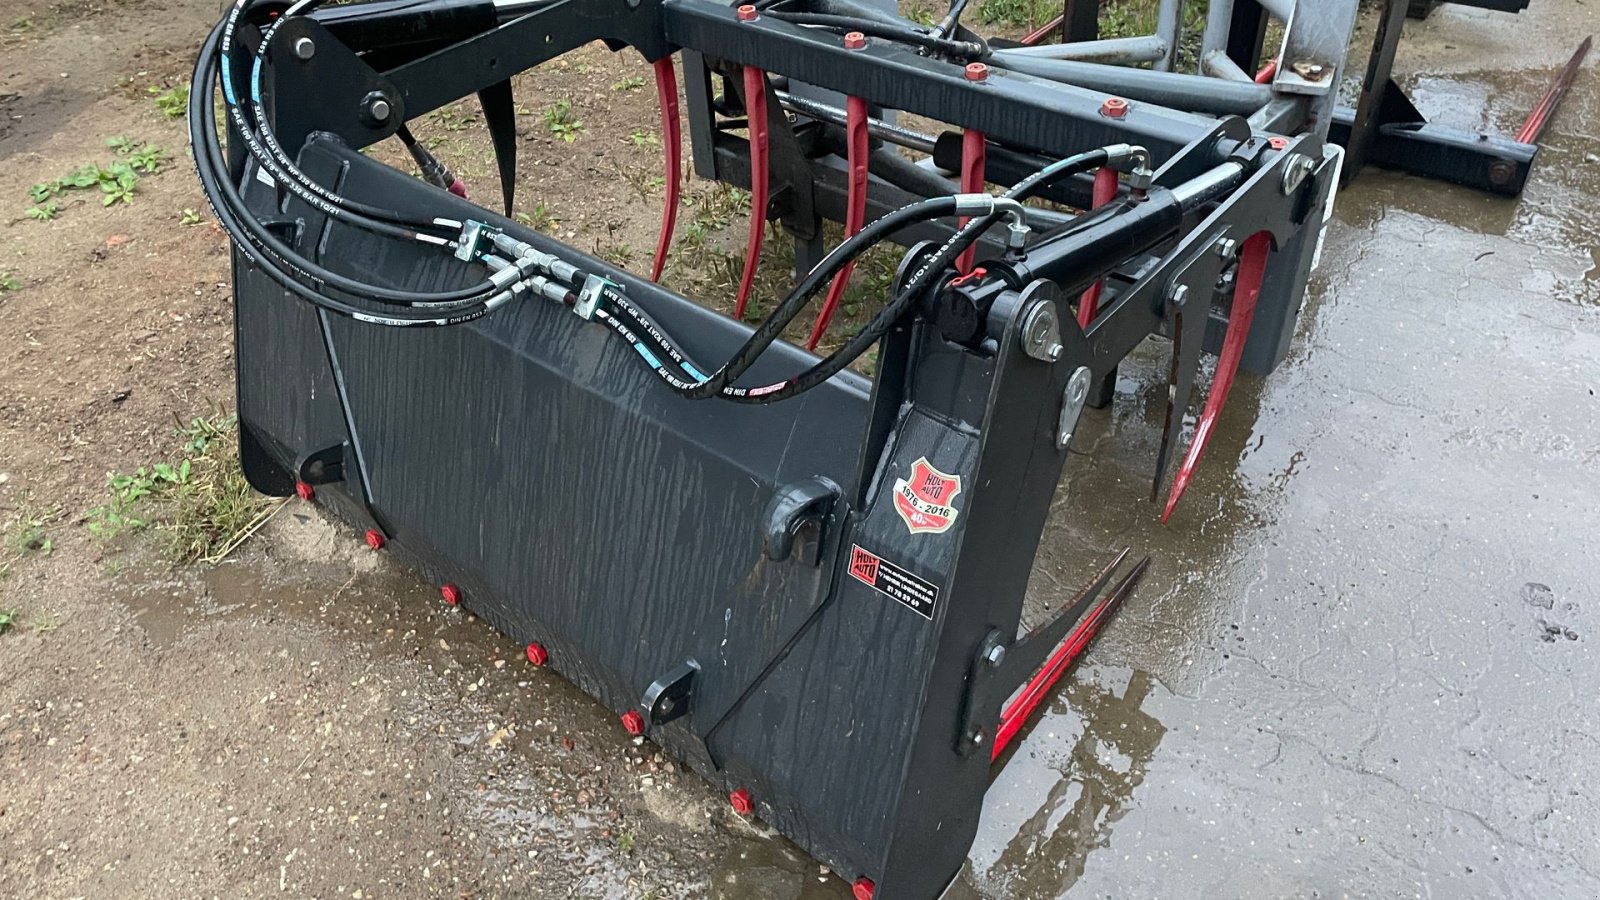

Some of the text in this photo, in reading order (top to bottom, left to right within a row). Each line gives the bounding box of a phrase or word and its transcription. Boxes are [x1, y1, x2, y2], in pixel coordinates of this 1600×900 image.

[222, 8, 240, 51] DIN EN 853
[257, 17, 284, 54] DIN EN 853
[231, 108, 244, 125] SAE
[240, 126, 252, 140] 100
[278, 172, 290, 183] WP
[289, 182, 302, 194] 330
[302, 191, 319, 205] BAR
[254, 105, 264, 122] SAE
[260, 123, 268, 136] 100
[288, 165, 299, 176] WP
[298, 175, 310, 186] 330
[309, 183, 325, 195] BAR
[603, 288, 619, 302] BAR
[618, 299, 629, 310] 330
[627, 307, 639, 319] WP
[607, 317, 620, 329] DIN
[618, 325, 628, 336] EN
[661, 340, 671, 352] 100
[669, 348, 682, 363] SAE
[723, 386, 734, 395] EN
[734, 387, 747, 396] DIN
[924, 473, 946, 486] HOLT
[921, 486, 943, 499] AUTO
[902, 485, 920, 507] 1976
[924, 504, 951, 517] 2016
[856, 550, 878, 564] HOLT
[854, 563, 876, 578] AUTO
[886, 585, 894, 594] 21
[902, 593, 911, 603] 29
[910, 599, 920, 608] 69
